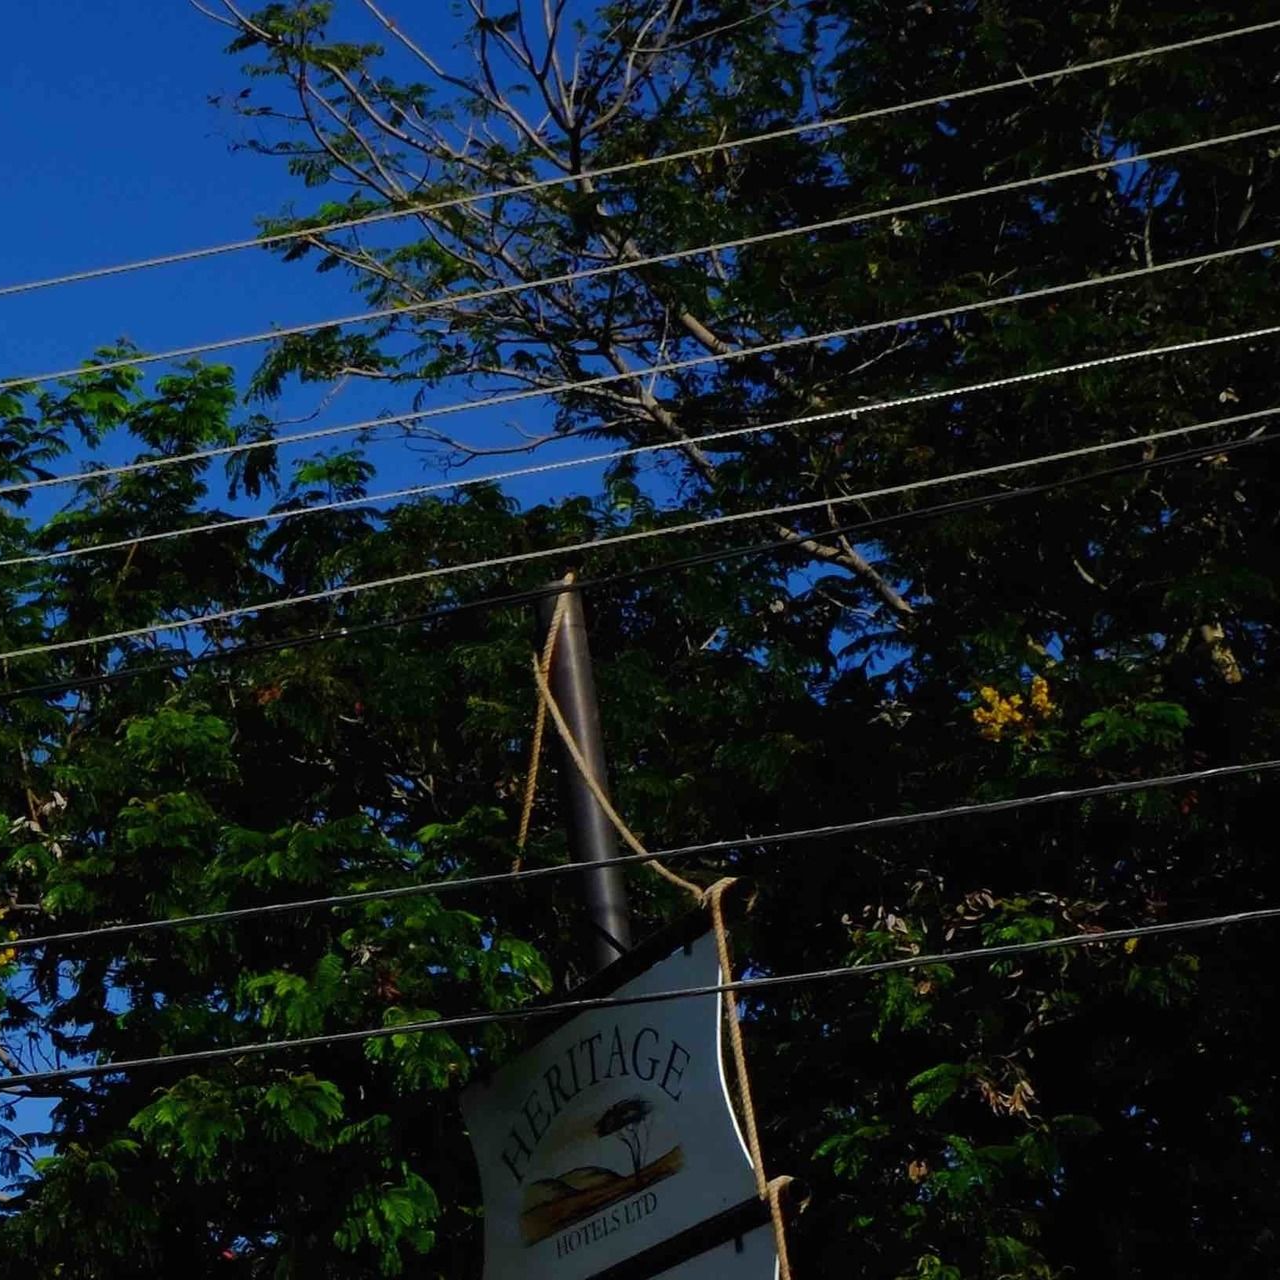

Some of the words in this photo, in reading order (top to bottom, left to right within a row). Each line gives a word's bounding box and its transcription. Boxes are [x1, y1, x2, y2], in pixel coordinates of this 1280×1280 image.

[501, 1024, 691, 1184] HERITAGE
[555, 1211, 622, 1259] HOTELS
[624, 1191, 658, 1223] LTD
